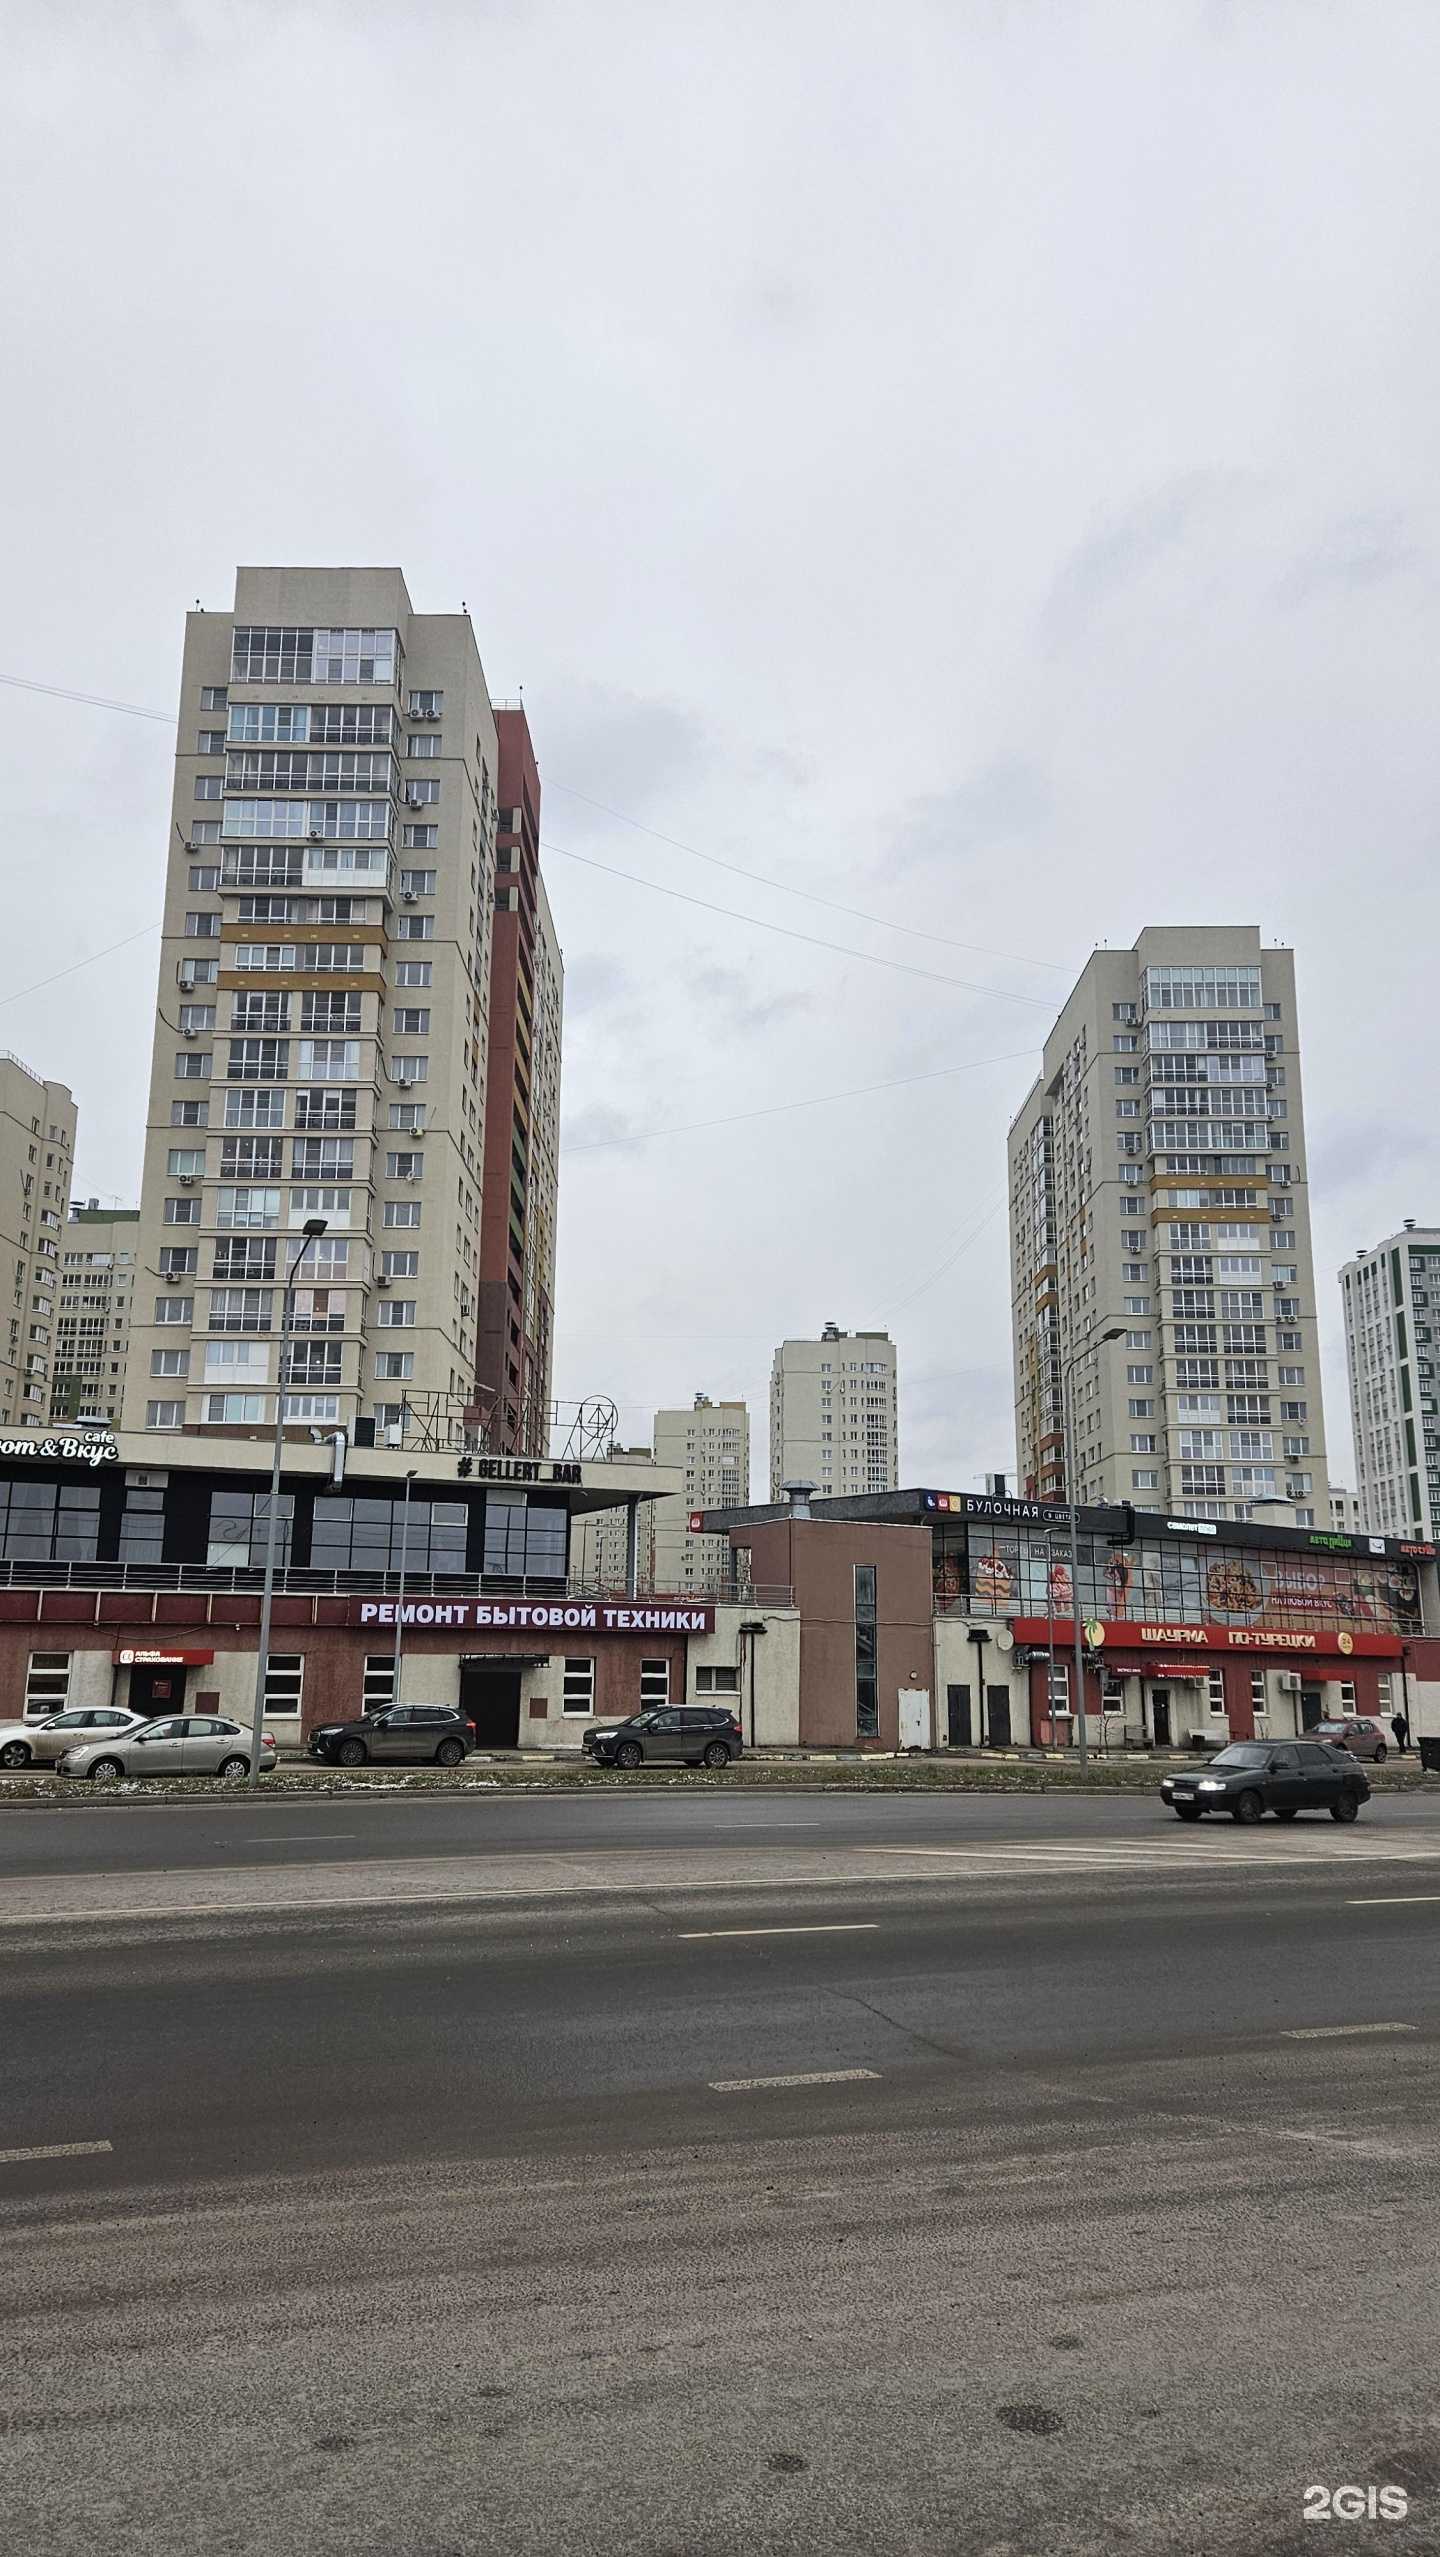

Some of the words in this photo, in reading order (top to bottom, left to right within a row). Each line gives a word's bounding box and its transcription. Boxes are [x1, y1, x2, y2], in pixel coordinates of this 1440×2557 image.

[84, 1430, 115, 1444] cafe
[39, 1439, 60, 1457] &
[59, 1437, 118, 1467] Вкус
[966, 1499, 1039, 1518] БУЛОЧНАЯ
[1034, 1547, 1045, 1556] НА
[1051, 1549, 1073, 1559] ЗАКАЗ
[360, 1603, 469, 1624] РЕМОНТ
[476, 1604, 596, 1627] БЫТОВОЙ
[603, 1609, 706, 1630] ТЕХНИКИ
[1141, 1627, 1209, 1643] ШАУРМА
[1228, 1631, 1316, 1648] ПО-ТУРЕЦКИ
